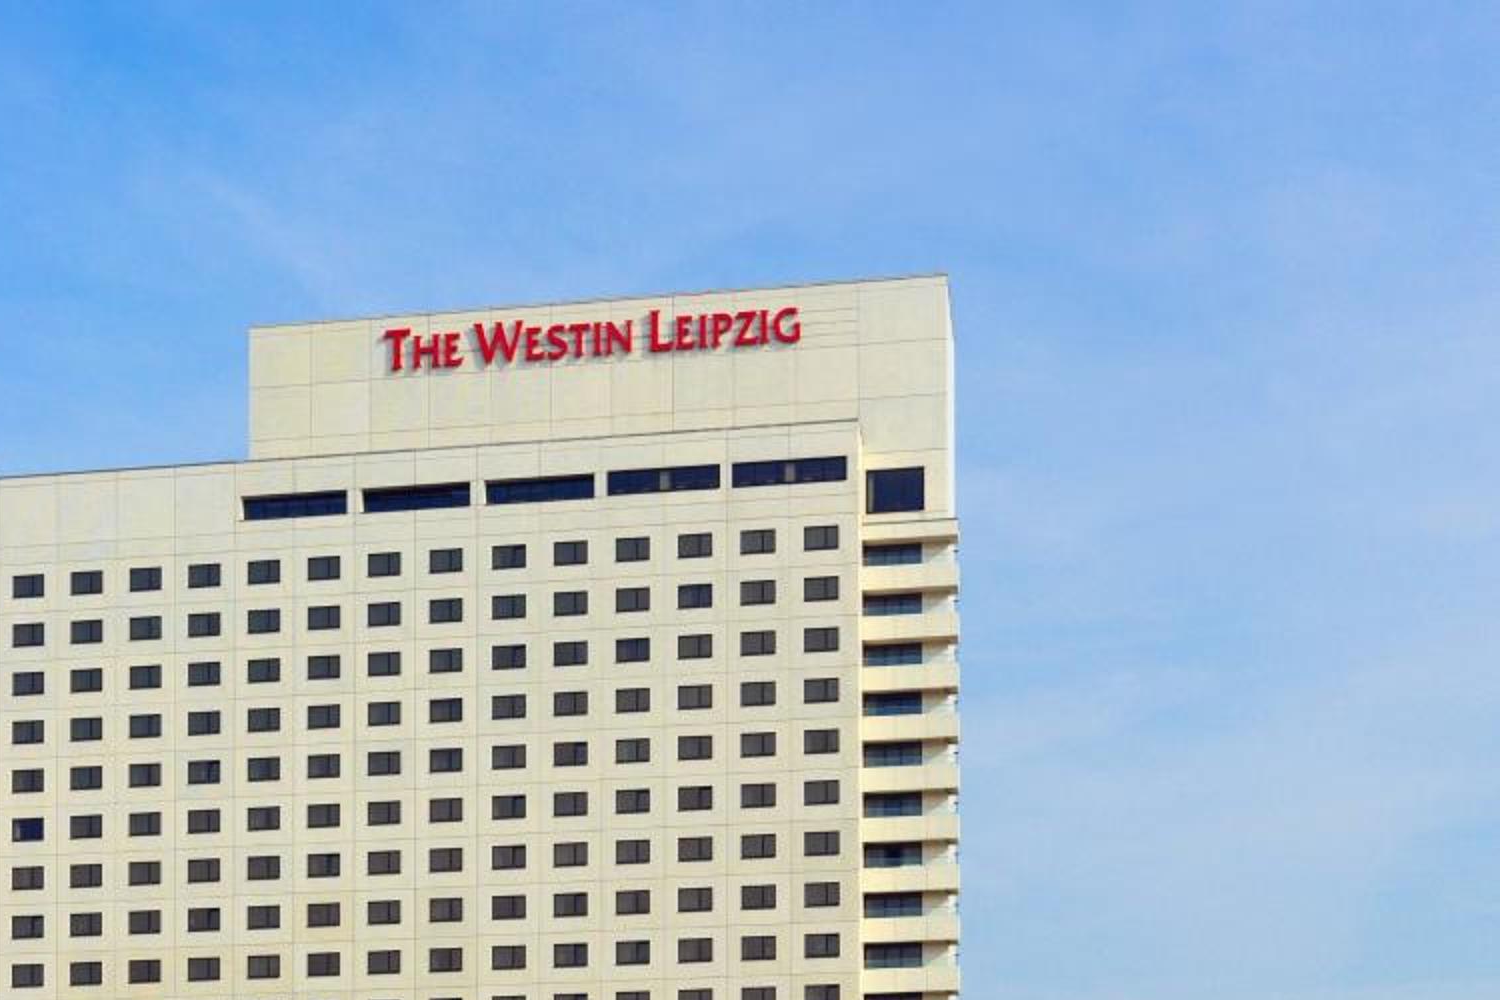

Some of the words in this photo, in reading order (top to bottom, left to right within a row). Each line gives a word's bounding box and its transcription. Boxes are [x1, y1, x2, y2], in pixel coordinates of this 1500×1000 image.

[384, 327, 465, 371] THE
[473, 320, 633, 364] WESTIN
[649, 307, 802, 354] LEIPZIG
